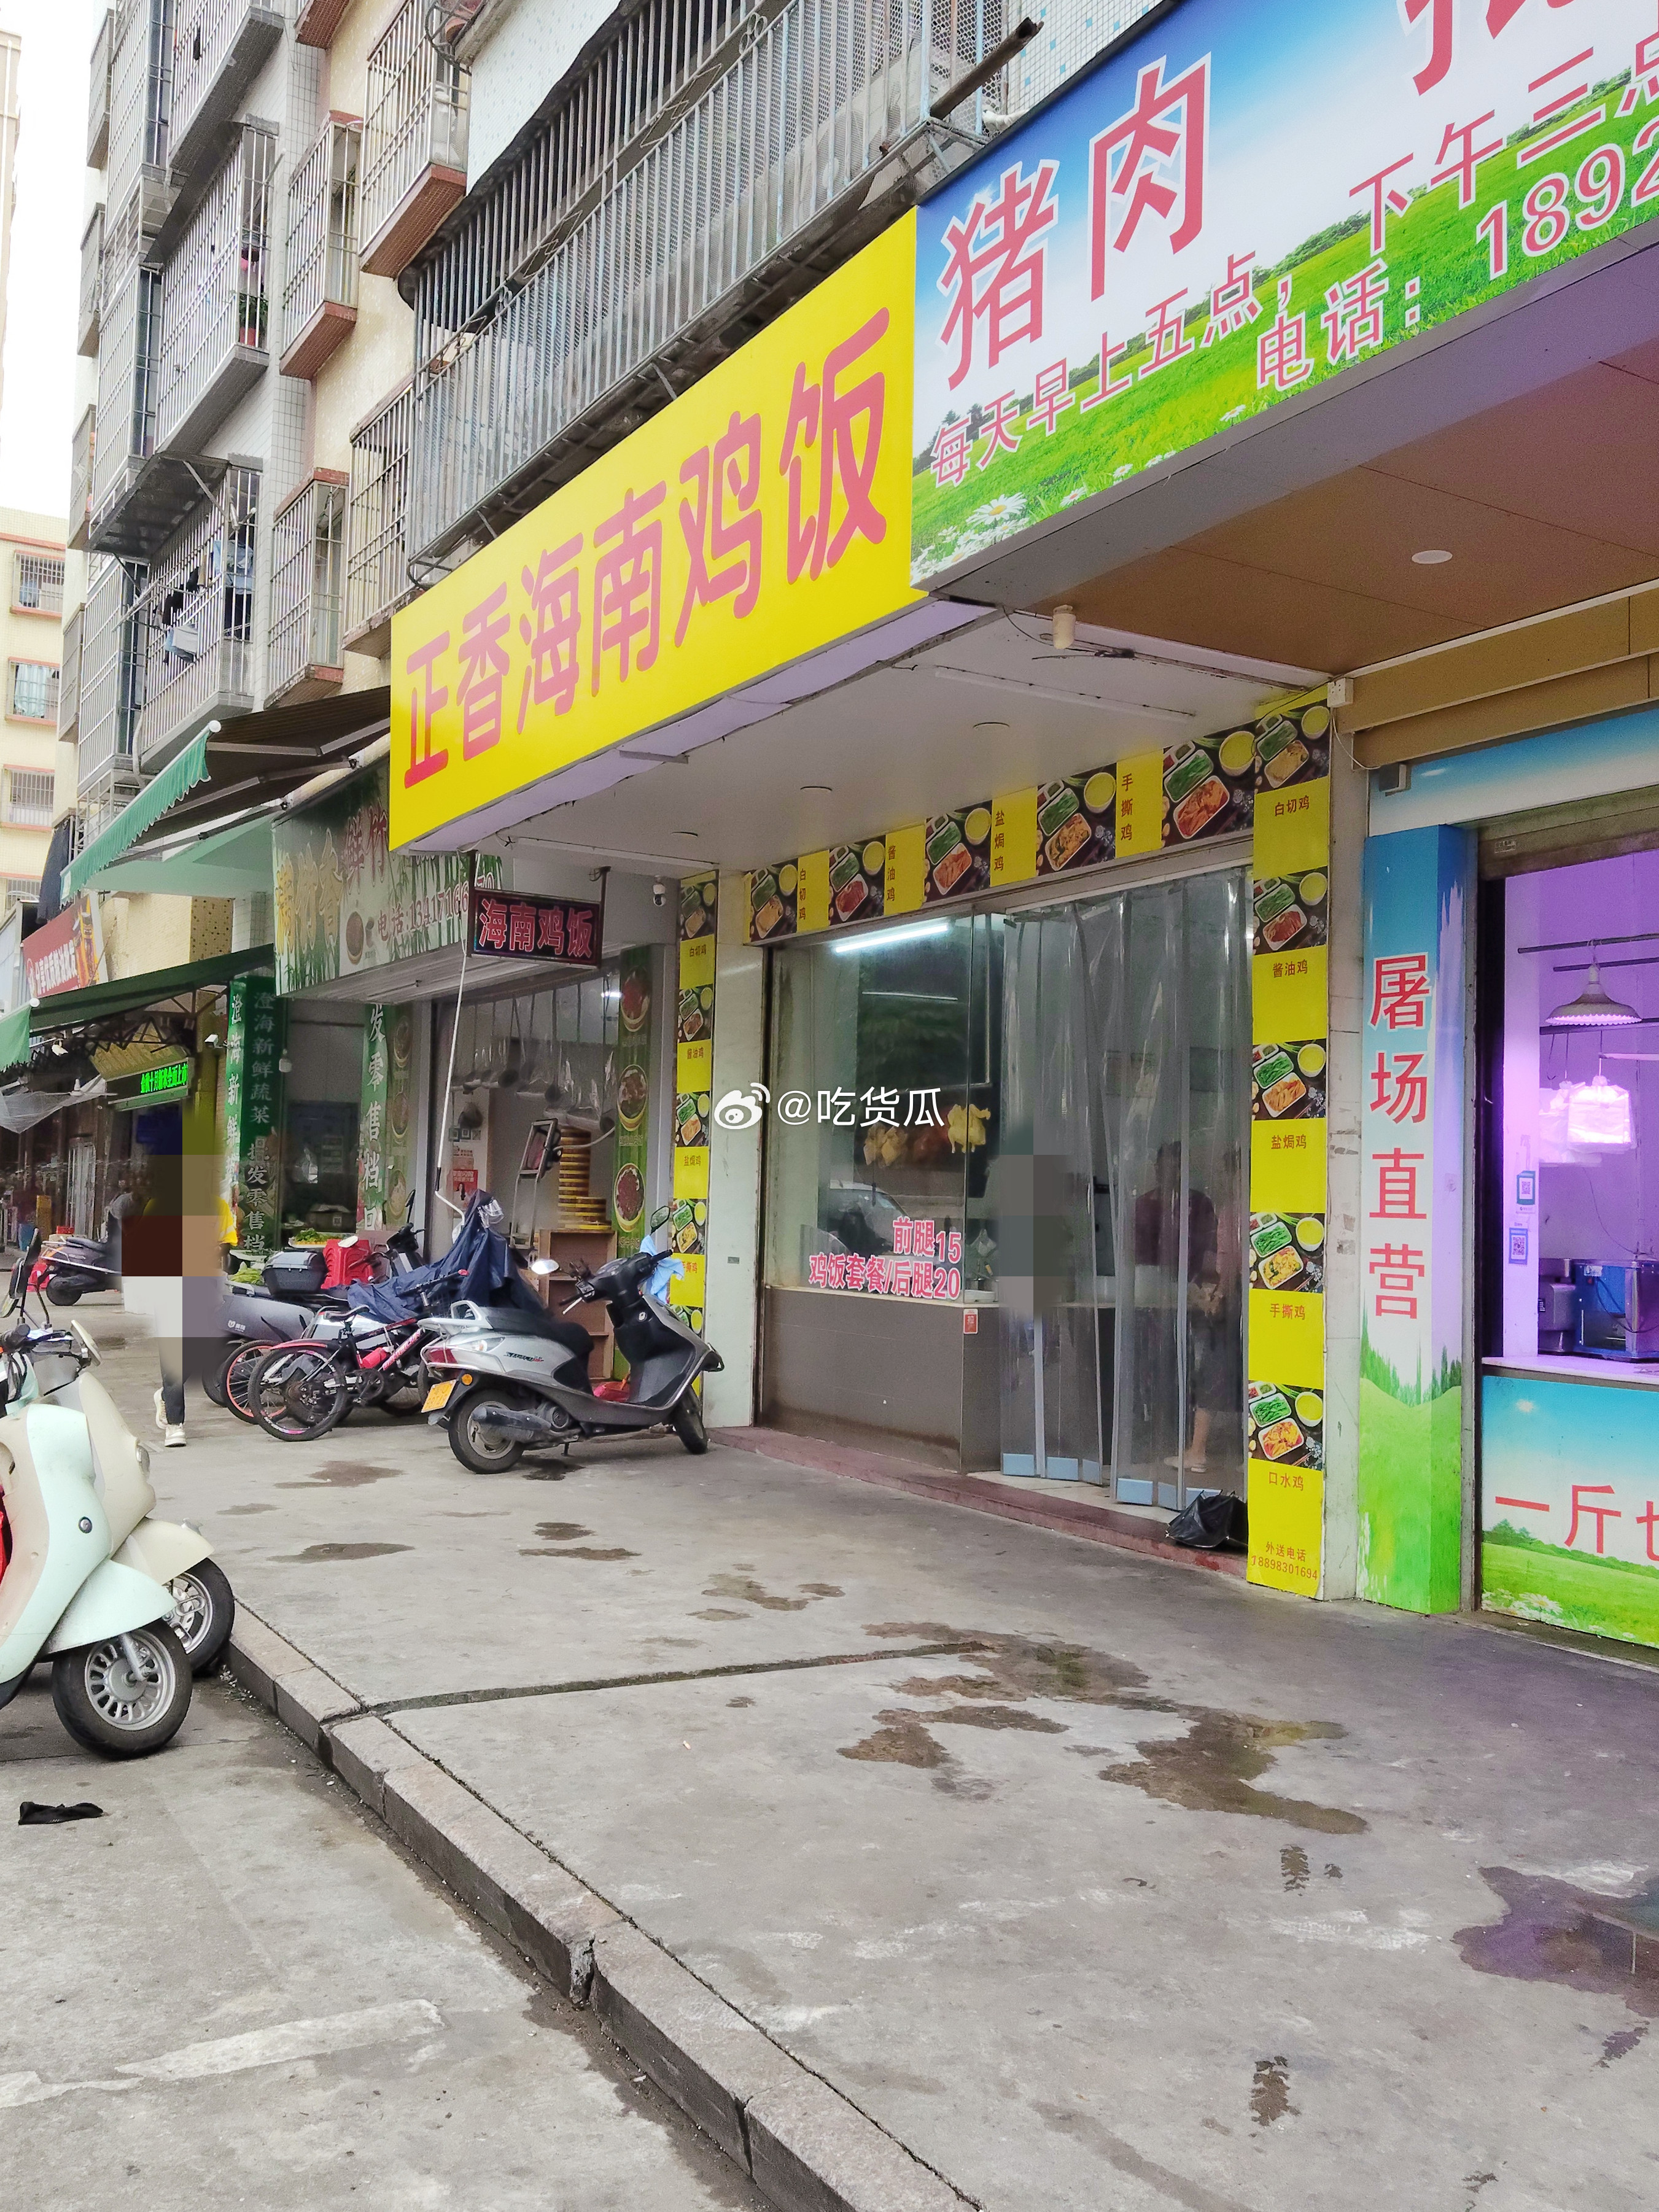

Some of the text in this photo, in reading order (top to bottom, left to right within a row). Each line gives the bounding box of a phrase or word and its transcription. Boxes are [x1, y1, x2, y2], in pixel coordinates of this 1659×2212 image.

[939, 55, 1210, 390] 猪肉
[403, 306, 890, 790] 正香海南鸡饭
[1121, 772, 1134, 842] 手撕鸡
[1274, 795, 1310, 817] 白切鸡
[993, 810, 1005, 872] 盐焗鸡
[886, 844, 896, 902] 酱油鸡
[478, 898, 594, 958] 海南鸡饭
[1272, 959, 1308, 979] 酱油鸡
[1271, 1134, 1307, 1150] 盐焗鸡
[1369, 954, 1431, 1320] 屠场直营
[893, 1216, 962, 1263] 前腿15
[1270, 1303, 1306, 1321] 手撕鸡
[1269, 1472, 1304, 1491] 口水鸡
[1251, 1555, 1318, 1581] 18898301694
[1265, 1541, 1307, 1562] 外送电话
